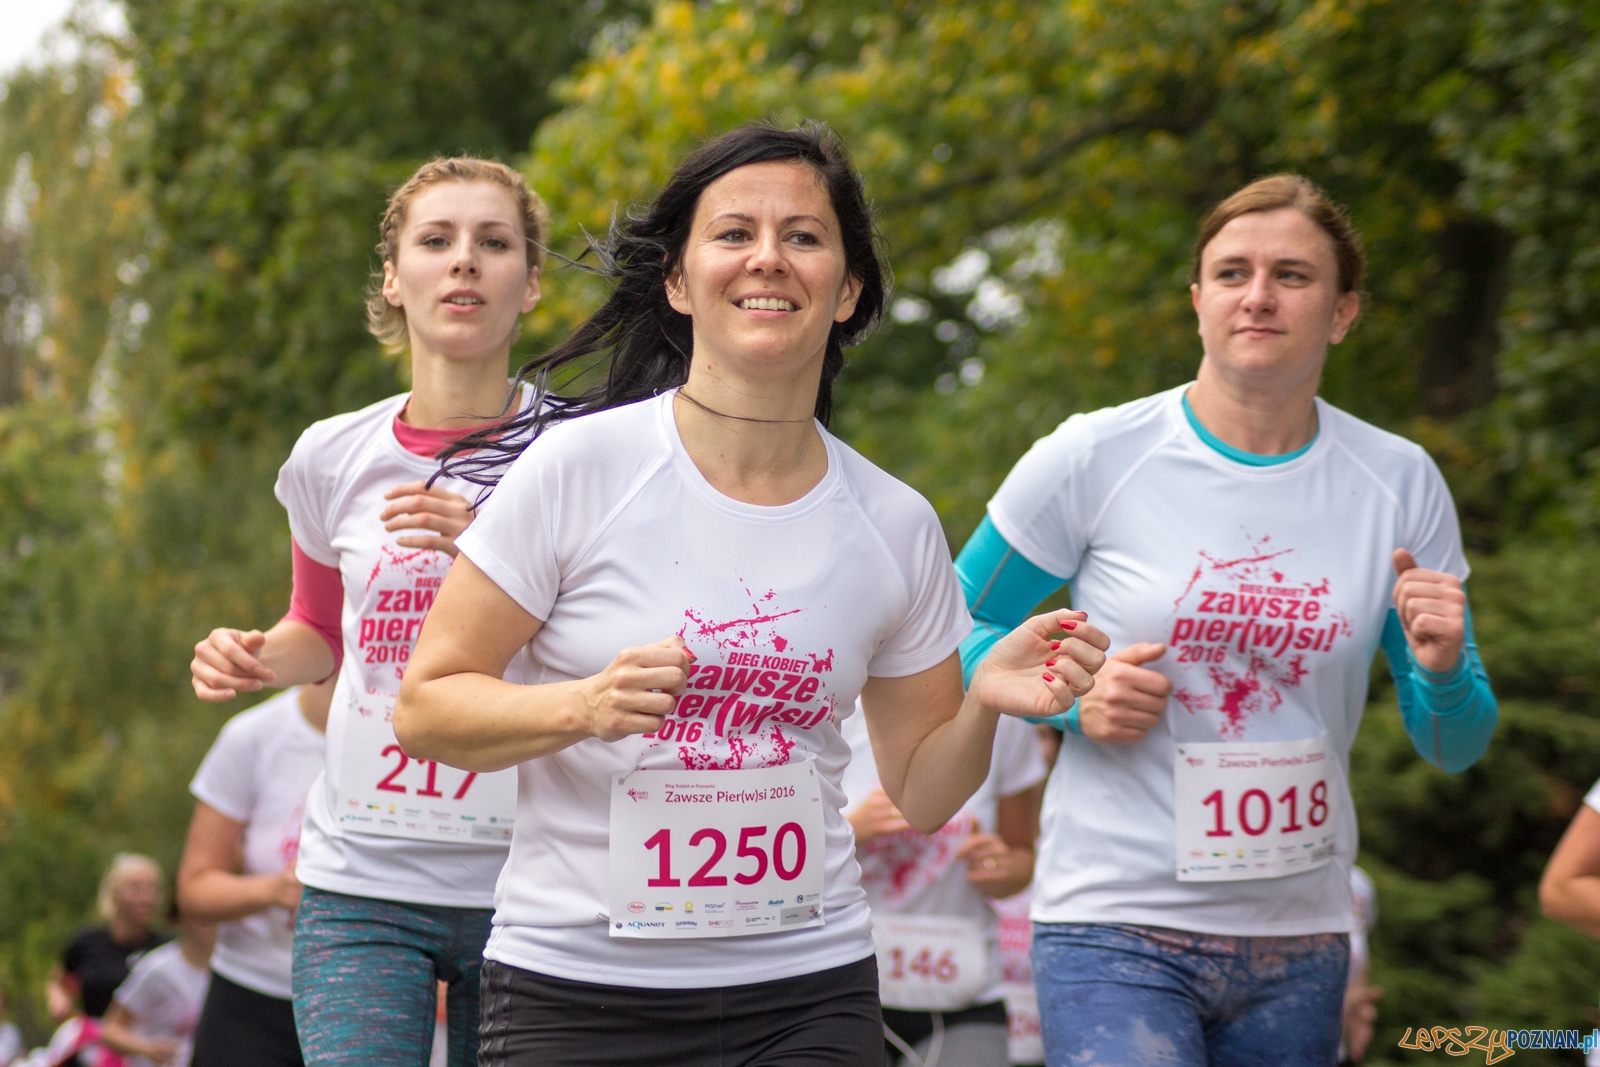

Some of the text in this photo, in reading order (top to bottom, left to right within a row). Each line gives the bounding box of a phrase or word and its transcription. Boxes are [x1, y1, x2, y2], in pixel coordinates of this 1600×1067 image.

[1238, 583, 1306, 599] BIEG KOBIET
[1197, 590, 1321, 621] zawsze
[1169, 617, 1339, 658] pier(w)si!
[364, 644, 410, 664] 2016
[727, 651, 810, 674] BIEG KOBIET
[1176, 645, 1227, 664] 2016
[642, 718, 704, 743] 016
[665, 785, 795, 804] Zawsze Pier(w)si 2016
[1202, 780, 1328, 838] 1018
[643, 822, 807, 887] 1250
[888, 945, 958, 983] 146
